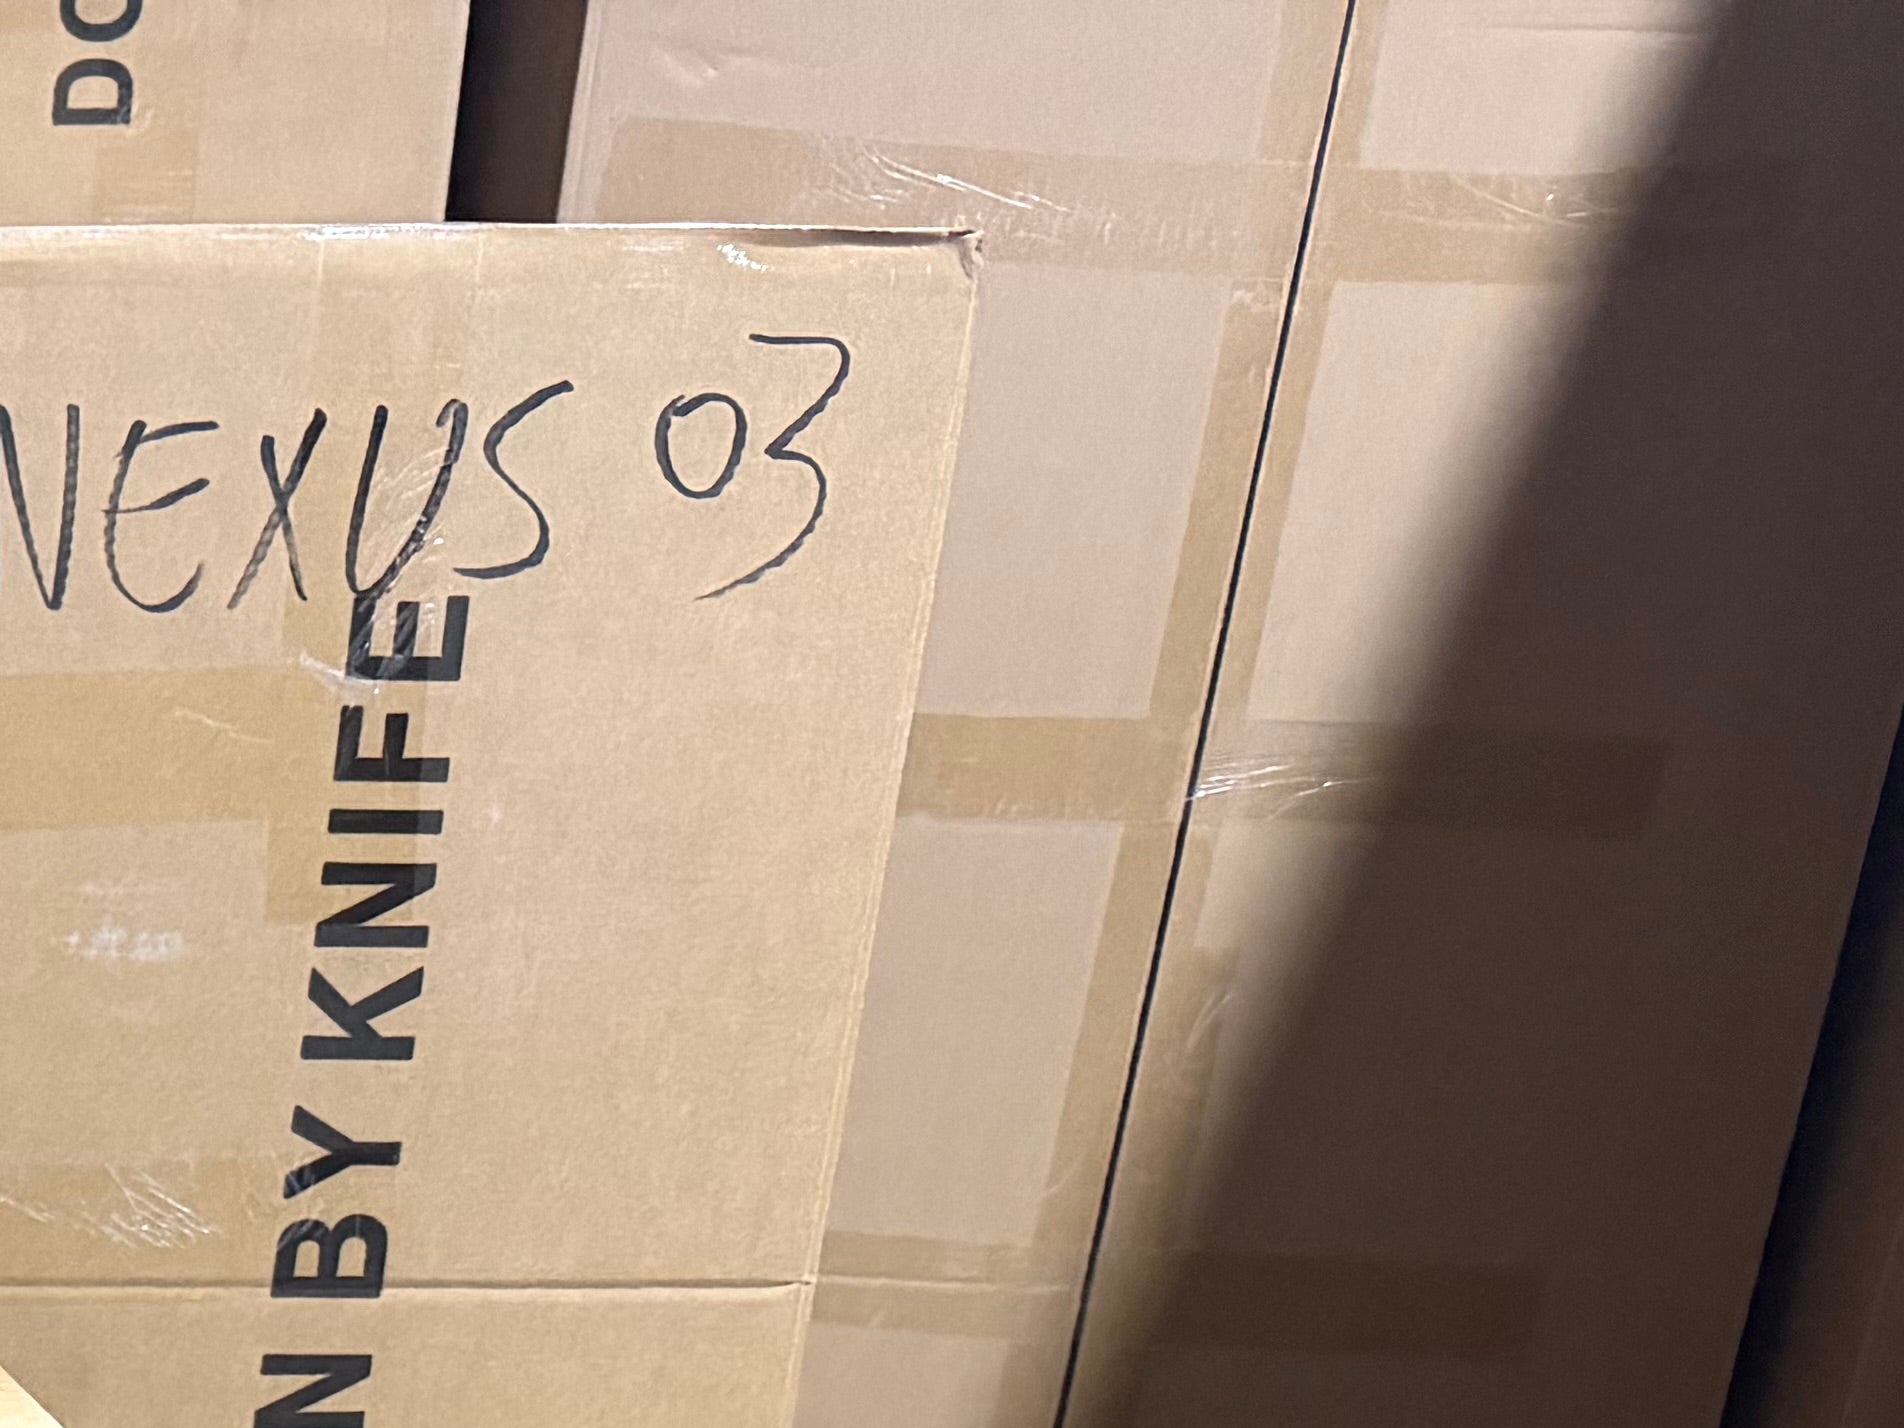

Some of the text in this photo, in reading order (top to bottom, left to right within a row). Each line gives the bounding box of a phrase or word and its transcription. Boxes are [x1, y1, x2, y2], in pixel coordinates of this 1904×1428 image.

[654, 332, 851, 601] 03
[300, 595, 470, 1061] KNIFE
[270, 1105, 402, 1298] BY
